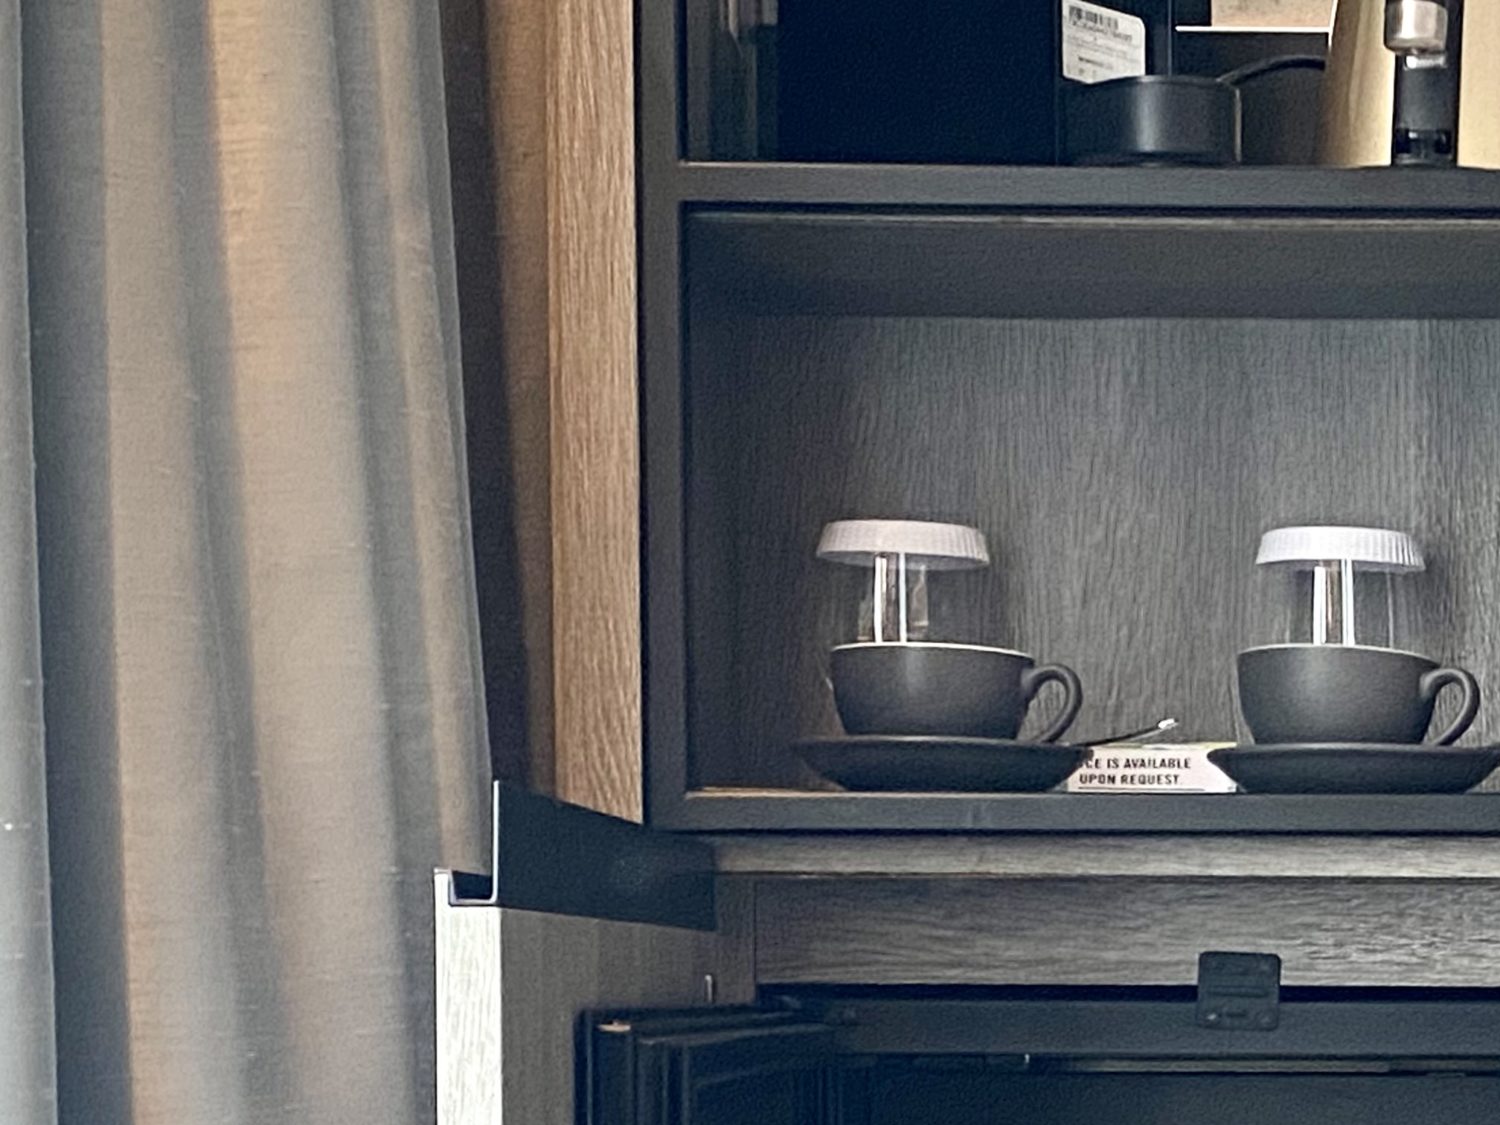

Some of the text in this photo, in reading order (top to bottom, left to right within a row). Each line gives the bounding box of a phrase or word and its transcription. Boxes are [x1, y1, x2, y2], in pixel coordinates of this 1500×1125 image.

[1083, 757, 1192, 769] CE IS AVAILABLE
[1079, 773, 1116, 785] UPON
